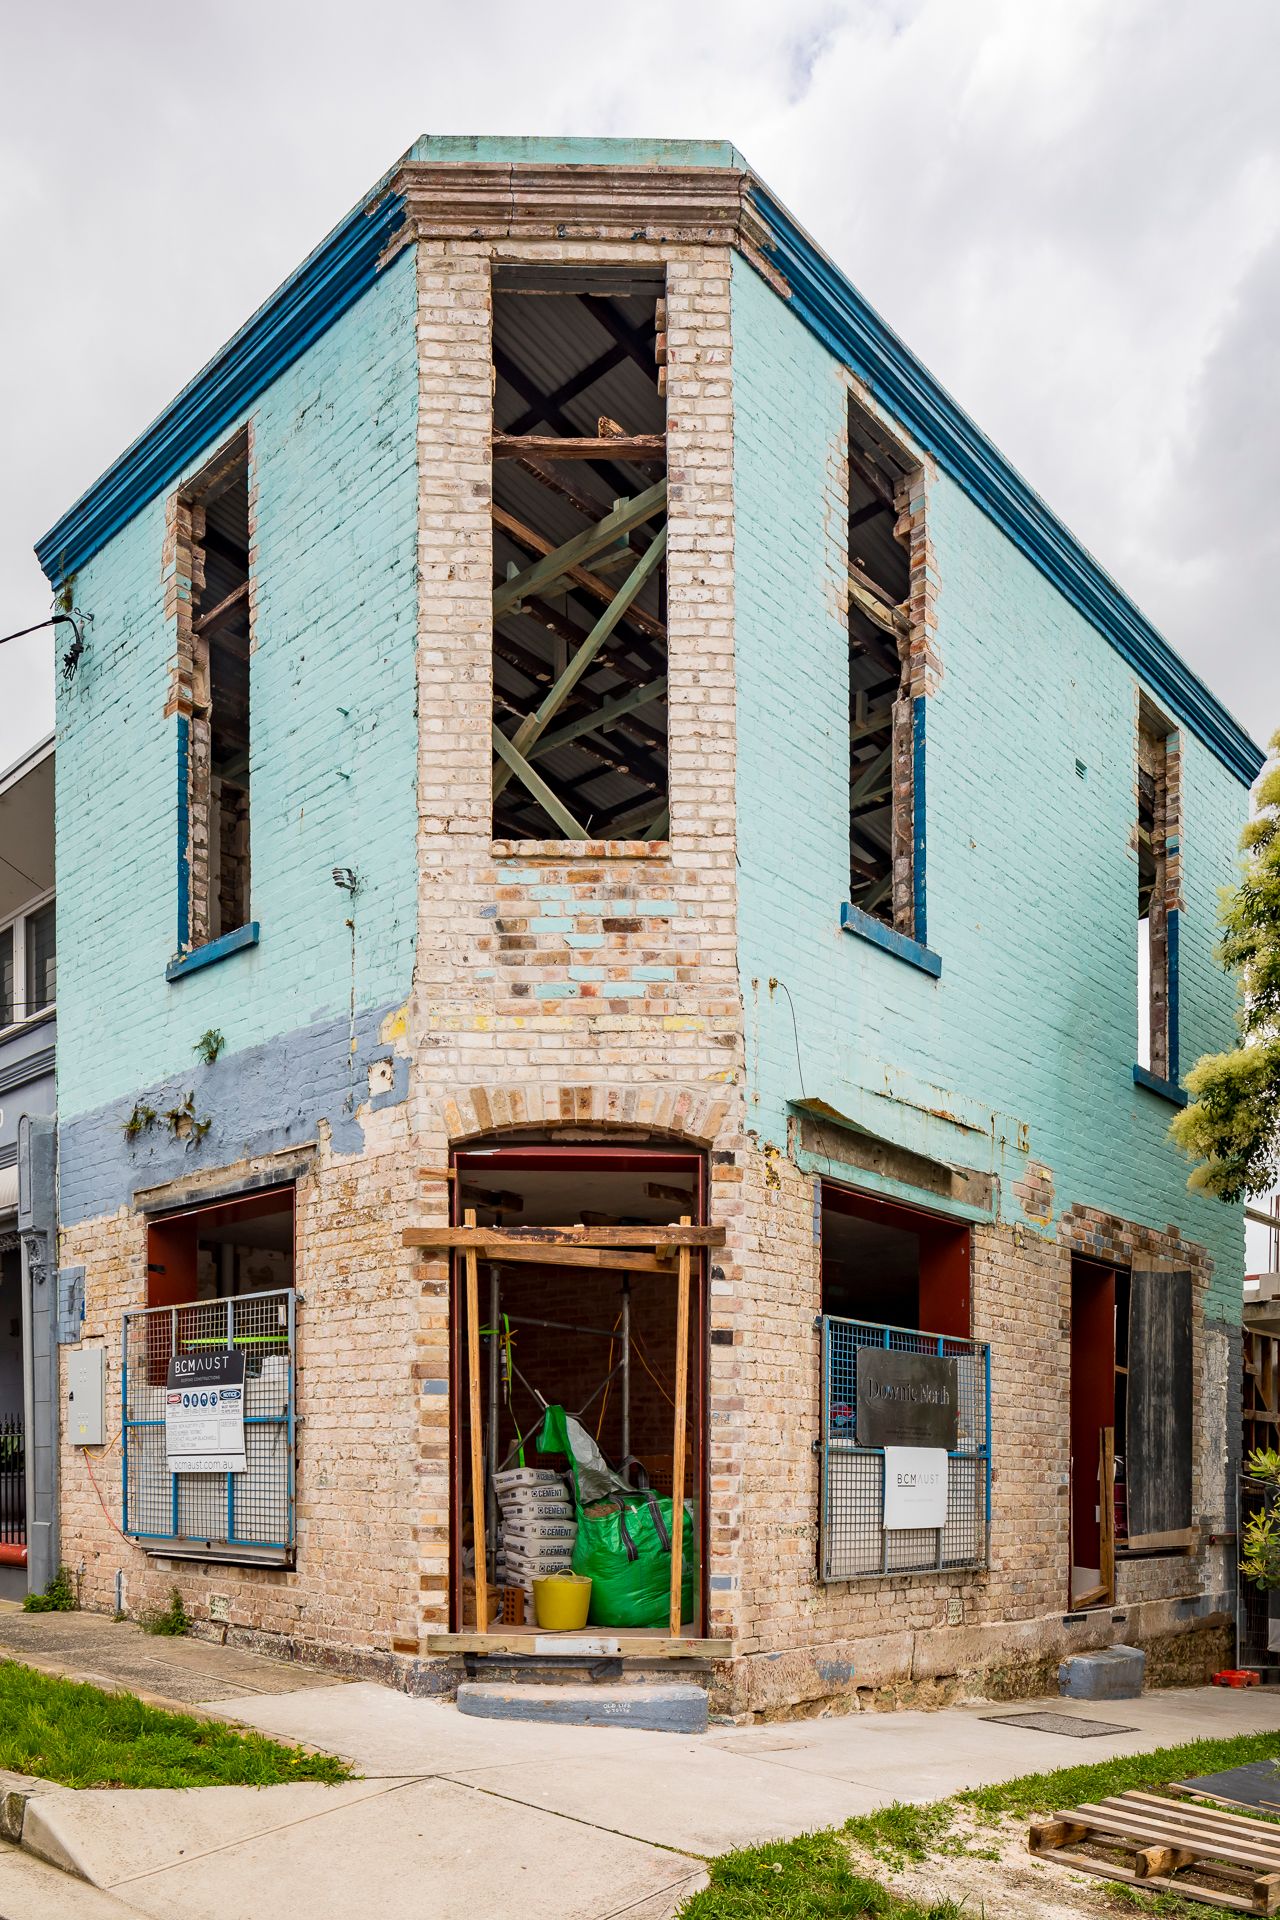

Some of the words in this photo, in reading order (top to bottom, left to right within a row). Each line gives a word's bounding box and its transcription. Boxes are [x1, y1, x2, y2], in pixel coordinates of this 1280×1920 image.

[920, 1383, 950, 1405] North
[897, 1473, 940, 1485] BCMAUST
[538, 1489, 562, 1498] CEMENT
[544, 1507, 567, 1515] CEMENT
[546, 1528, 572, 1536] CEMENT
[546, 1548, 571, 1556] CEMENT
